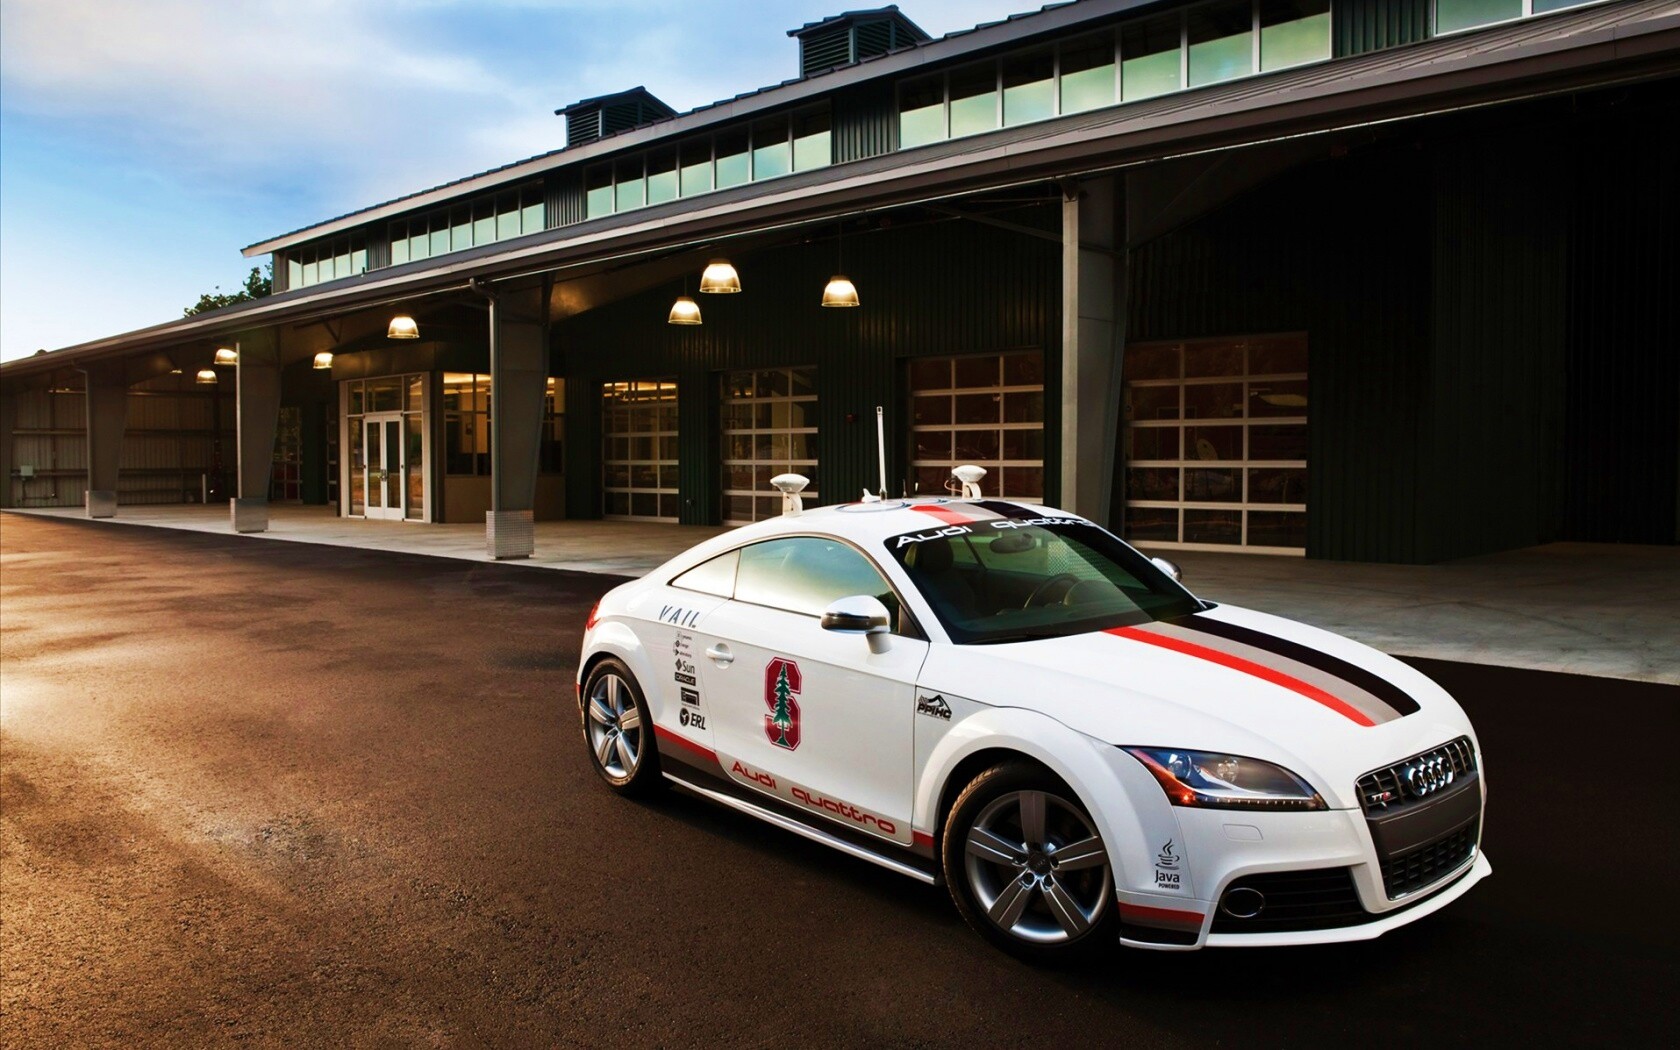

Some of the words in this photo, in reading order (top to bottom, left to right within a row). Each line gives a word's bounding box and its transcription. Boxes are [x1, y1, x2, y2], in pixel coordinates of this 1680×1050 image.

[896, 525, 972, 549] Audi
[659, 605, 700, 628] VAIL
[682, 660, 695, 674] Sun
[690, 712, 706, 730] ERL
[732, 761, 777, 789] Audi
[791, 787, 895, 835] quattro
[1155, 870, 1180, 883] Java
